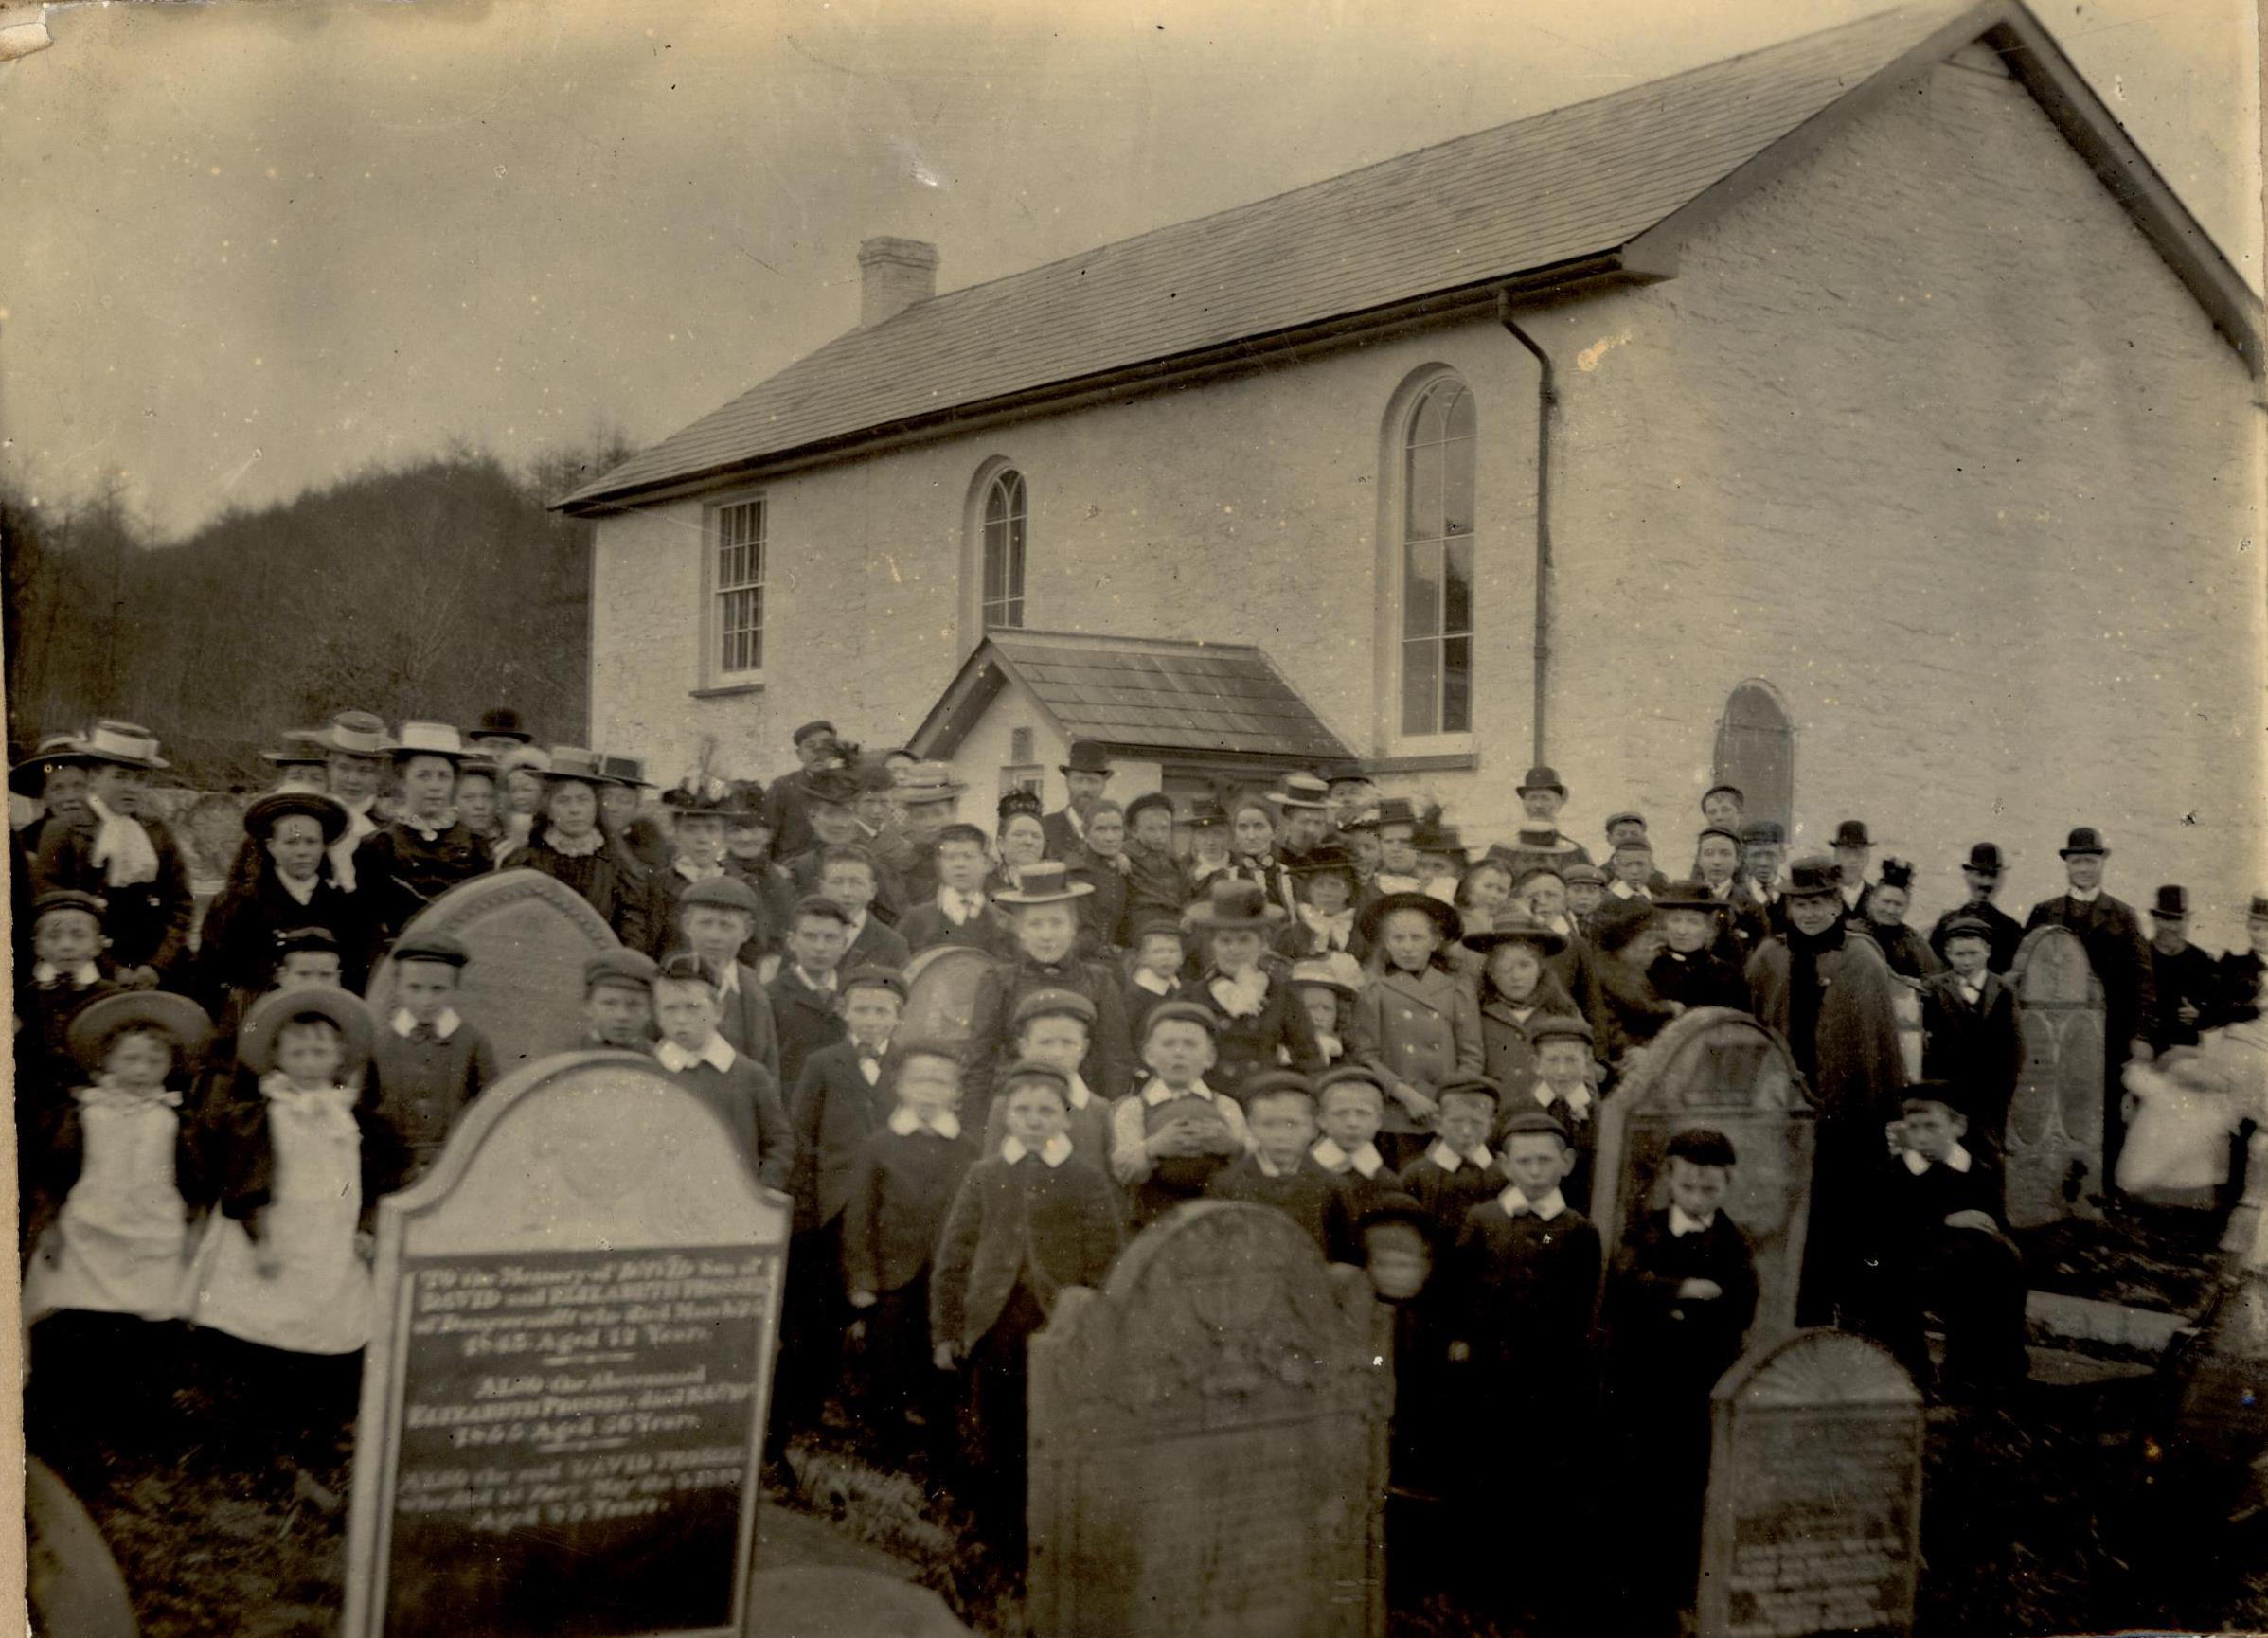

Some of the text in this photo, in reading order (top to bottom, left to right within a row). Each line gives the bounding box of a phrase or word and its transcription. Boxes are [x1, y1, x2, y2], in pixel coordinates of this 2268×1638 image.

[504, 1287, 548, 1309] and
[532, 1326, 602, 1357] Aged
[529, 1416, 595, 1444] Aged
[571, 1451, 654, 1480] DAVID
[470, 1503, 540, 1536] Aged
